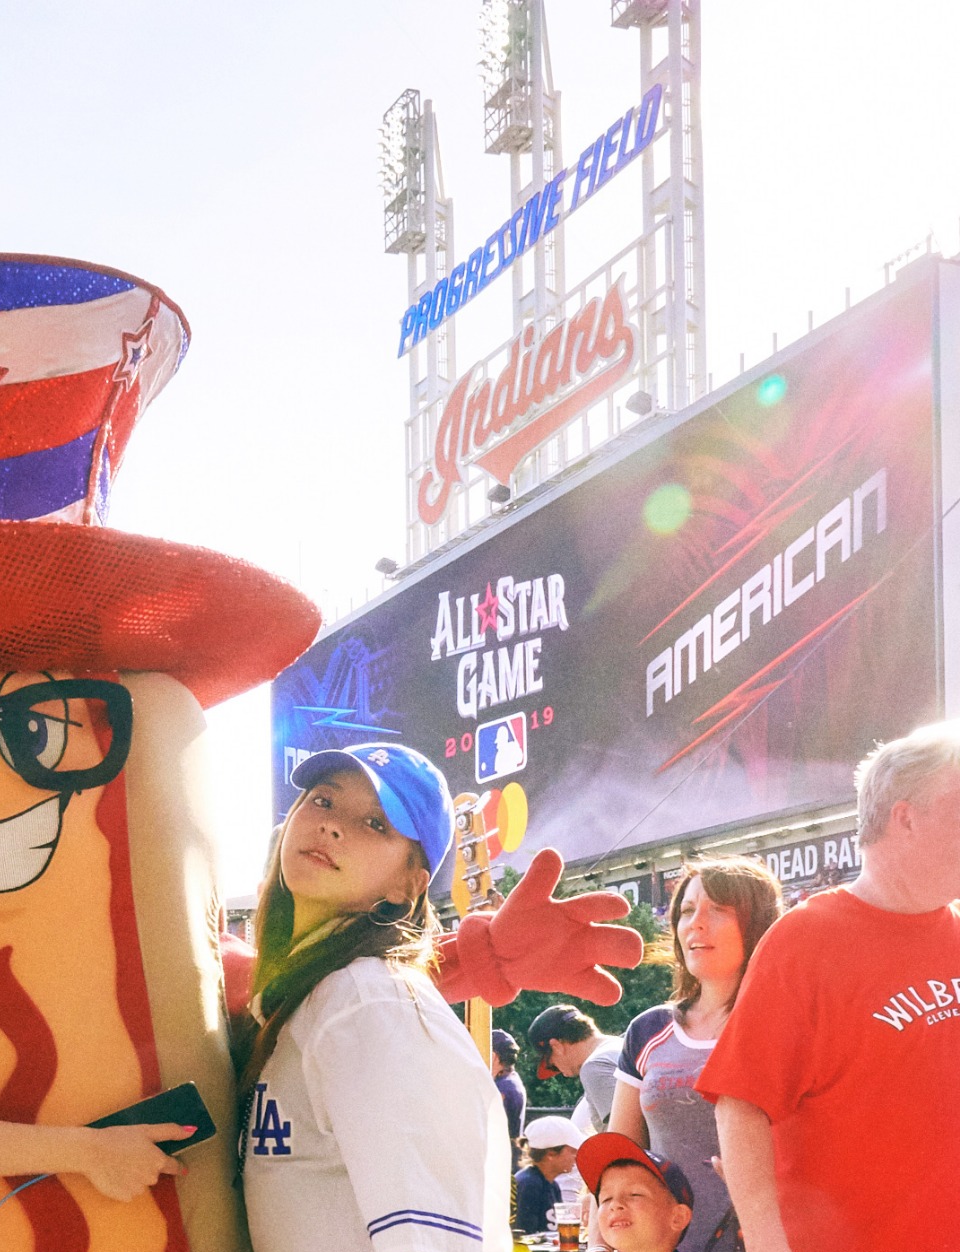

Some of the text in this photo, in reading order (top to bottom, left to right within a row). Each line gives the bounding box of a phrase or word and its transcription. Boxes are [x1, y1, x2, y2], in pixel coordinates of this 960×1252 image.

[398, 83, 662, 359] PROGRESSIVE FIELD
[417, 274, 640, 526] Indians
[430, 573, 569, 661] ALL STAR
[646, 467, 886, 718] AMERICAN
[456, 637, 543, 720] GAME
[445, 706, 554, 758] 20 19
[766, 844, 818, 880] DEAD
[251, 1083, 291, 1155] LA
